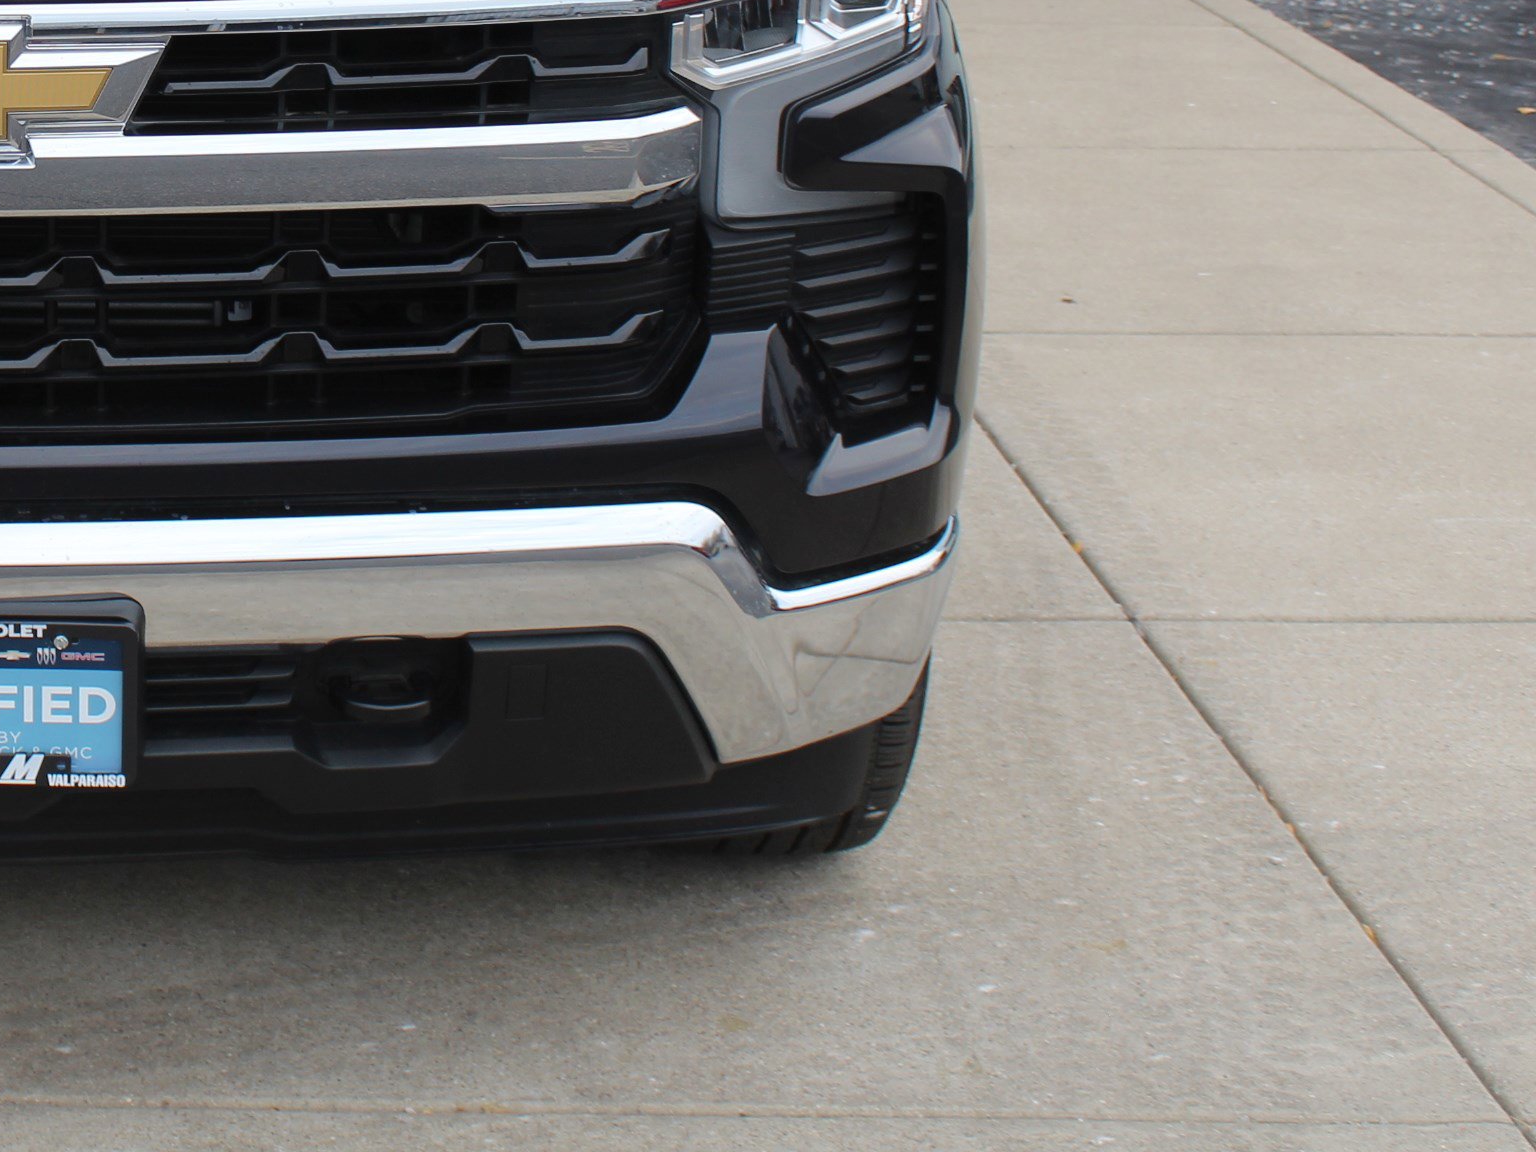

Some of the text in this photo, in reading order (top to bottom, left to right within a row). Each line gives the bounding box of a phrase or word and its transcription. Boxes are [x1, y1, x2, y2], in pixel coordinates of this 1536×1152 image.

[60, 652, 106, 662] GMC
[49, 746, 93, 760] GMC
[47, 773, 126, 787] VALPARAISO
